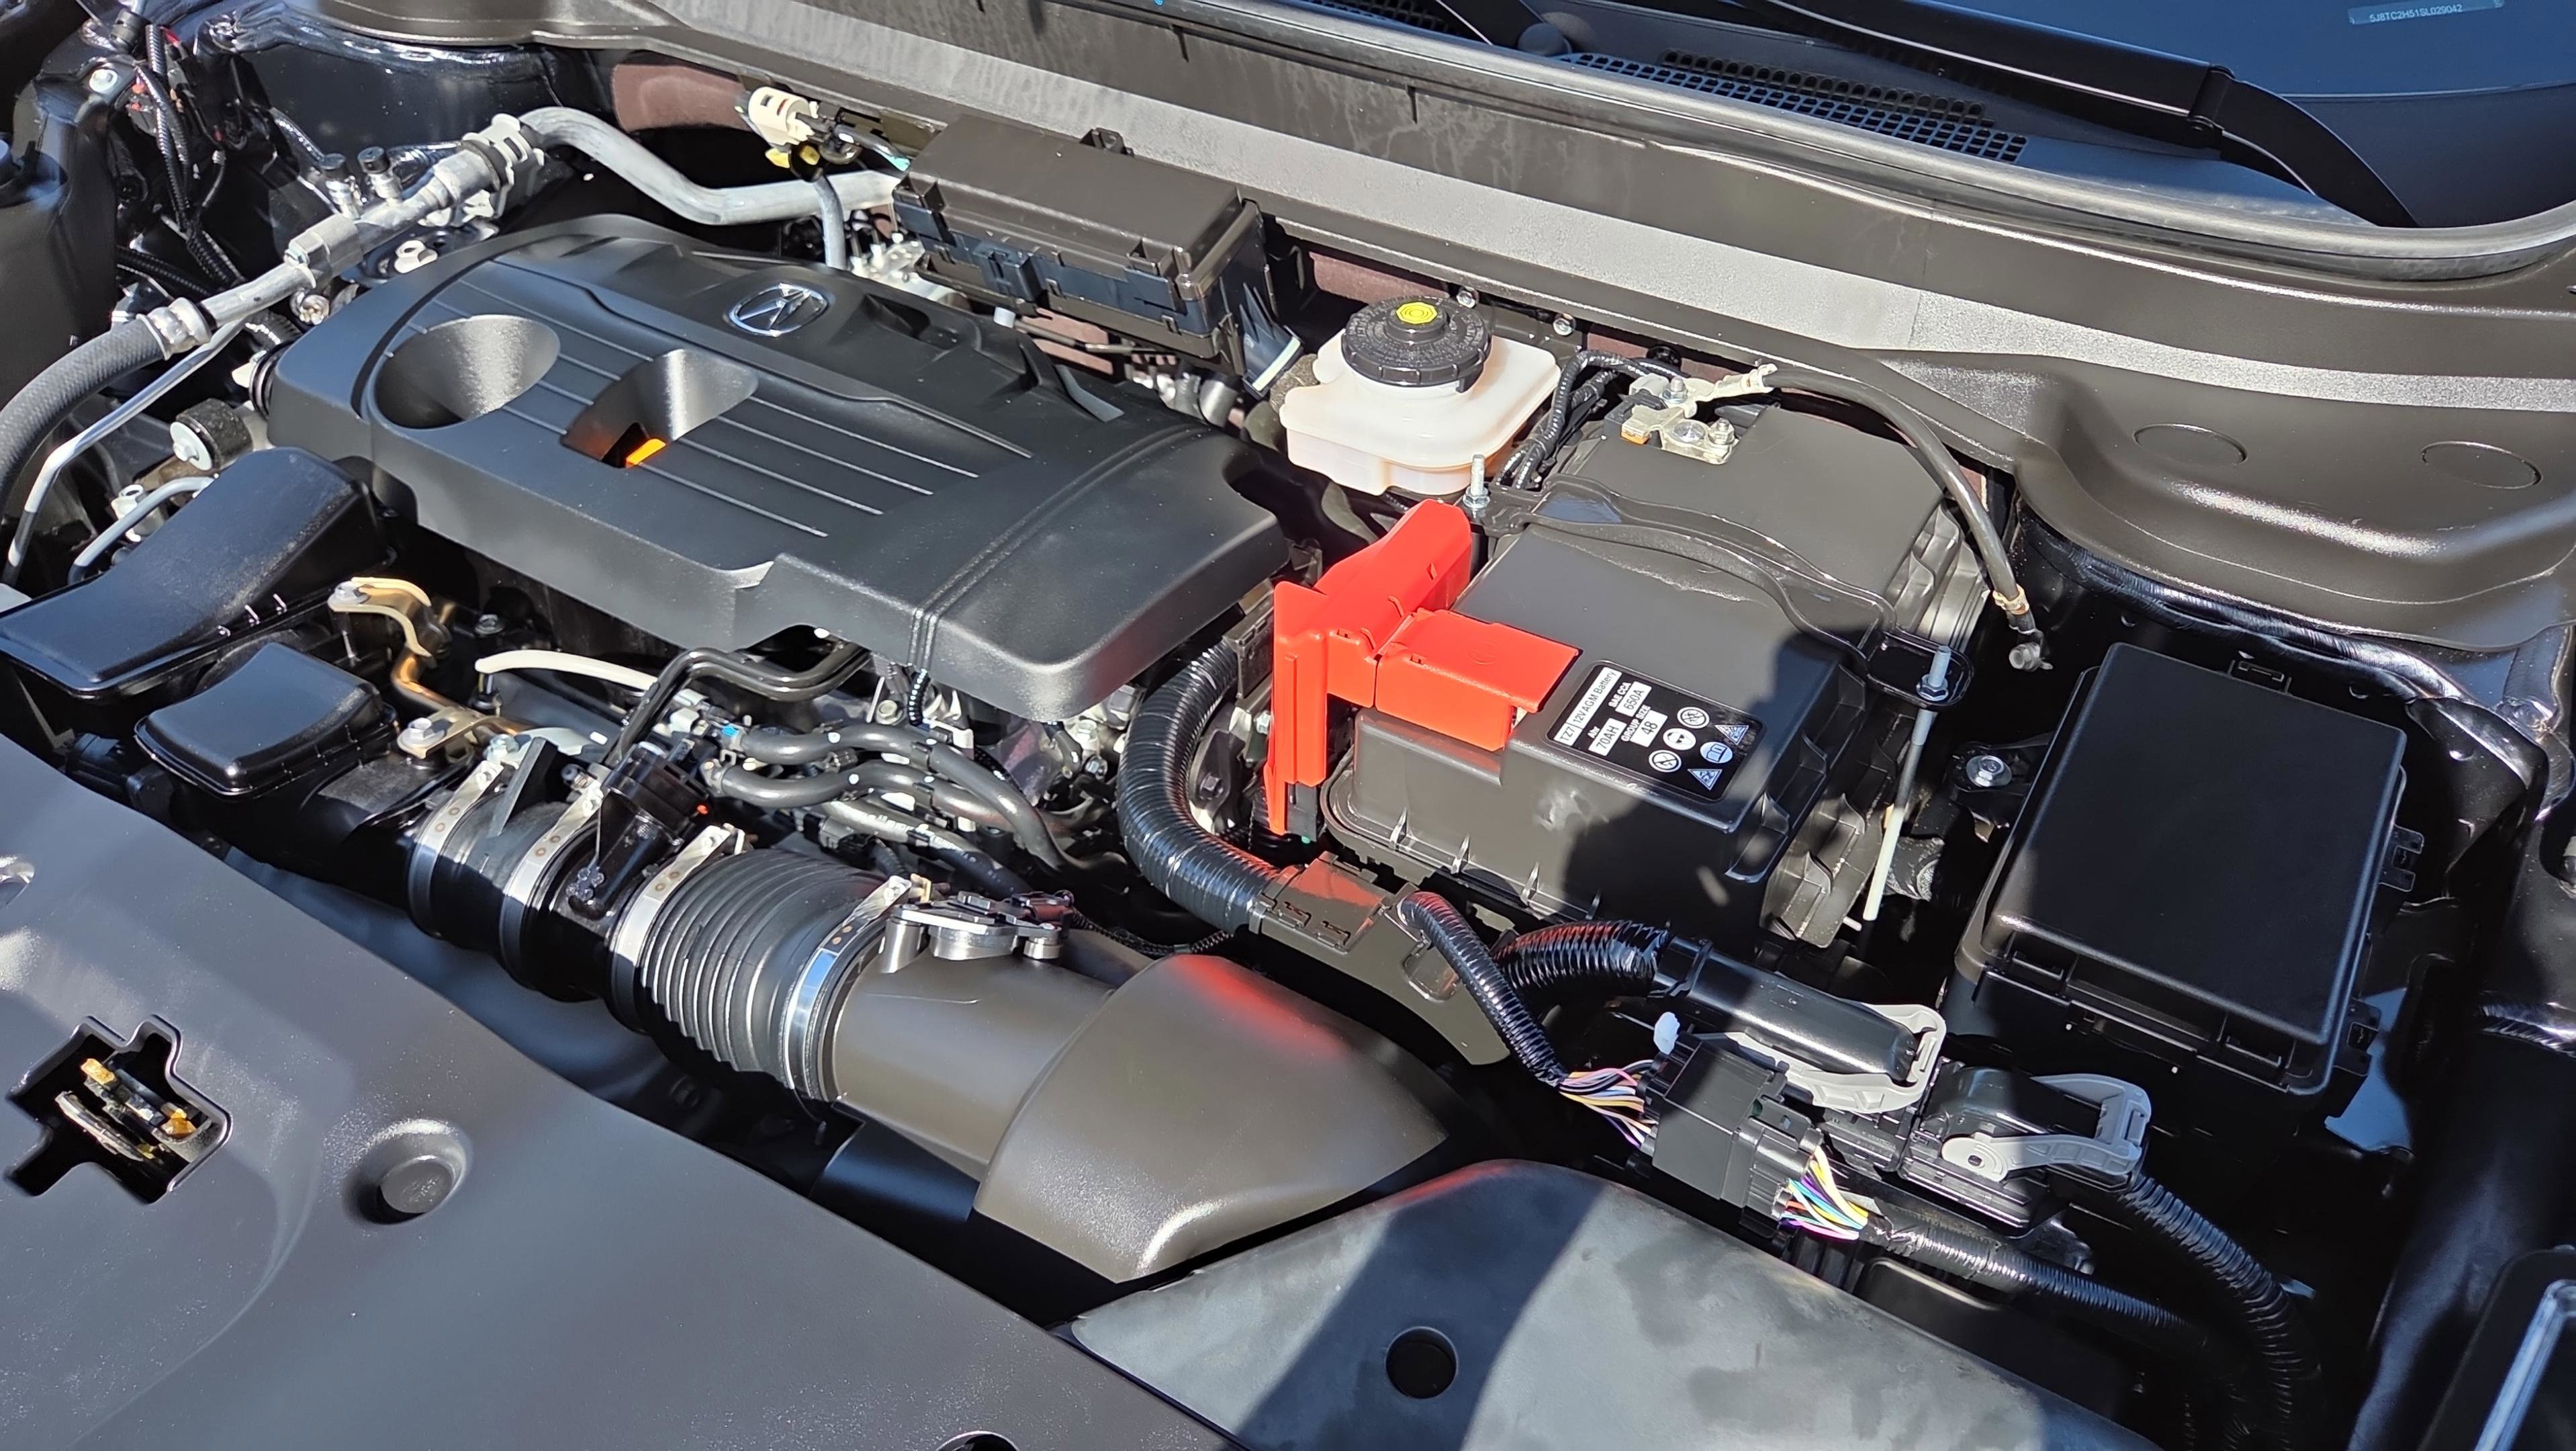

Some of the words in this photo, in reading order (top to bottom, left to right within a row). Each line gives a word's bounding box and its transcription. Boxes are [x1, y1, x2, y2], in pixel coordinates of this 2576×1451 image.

[2369, 4, 2463, 23] 5J8TC2H51SL029042
[1560, 726, 1575, 741] TZ7
[1594, 671, 1617, 694] Battery
[1608, 694, 1623, 707] SAE
[1617, 682, 1632, 695] CCA
[1624, 689, 1645, 709] 650A
[1620, 719, 1640, 742] GROUP
[1635, 704, 1651, 719] SIZE
[1641, 721, 1658, 735] 48
[1596, 725, 1620, 749] 70AH
